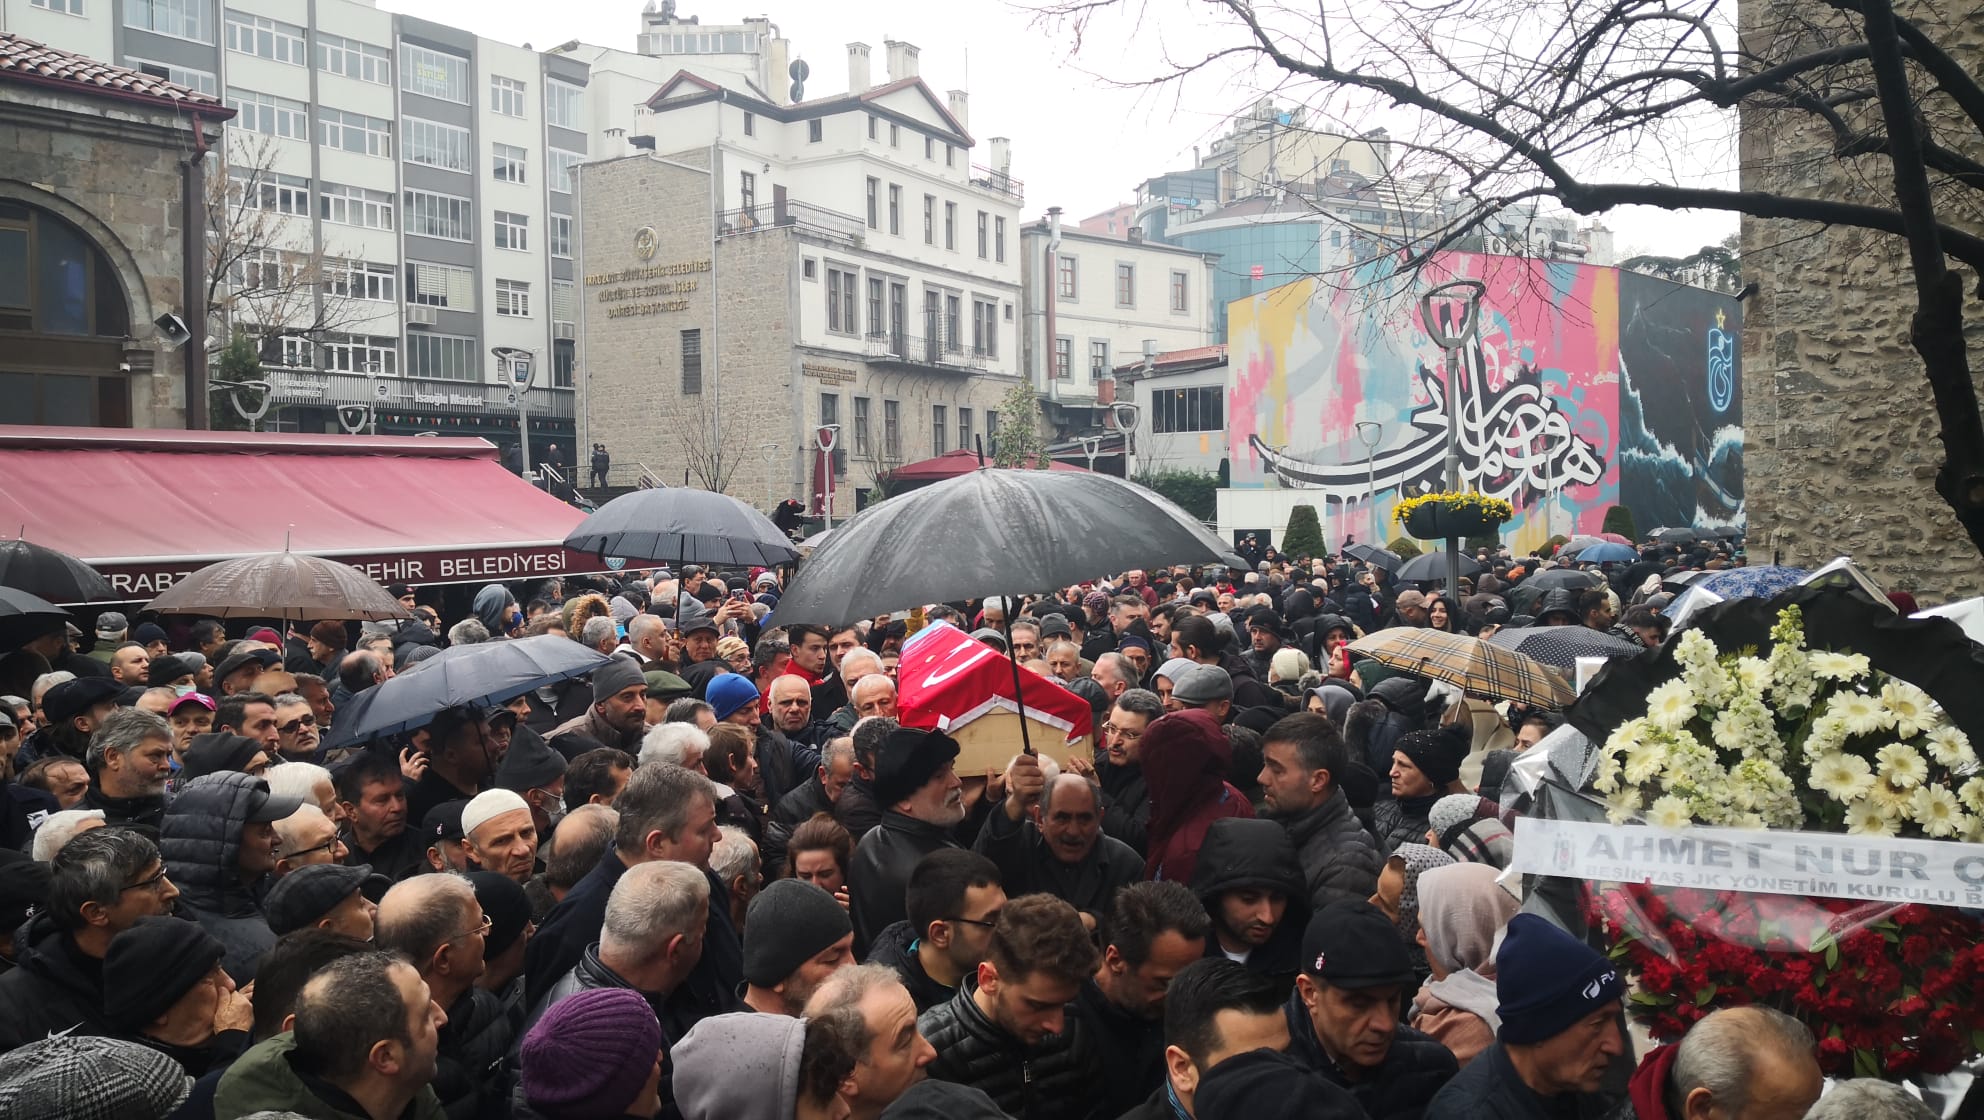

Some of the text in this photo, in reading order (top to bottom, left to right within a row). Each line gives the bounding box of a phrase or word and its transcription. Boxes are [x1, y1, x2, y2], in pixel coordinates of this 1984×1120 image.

[450, 393, 483, 406] Market
[440, 550, 567, 577] BELEDİYESİ
[1585, 833, 1771, 869] AHMET
[1795, 845, 1930, 881] NUR
[1586, 865, 1684, 885] BEŞİKTAŞ
[1692, 873, 1720, 886] JK
[1730, 872, 1838, 894] YÖNETİM
[1847, 883, 1955, 902] KURULU
